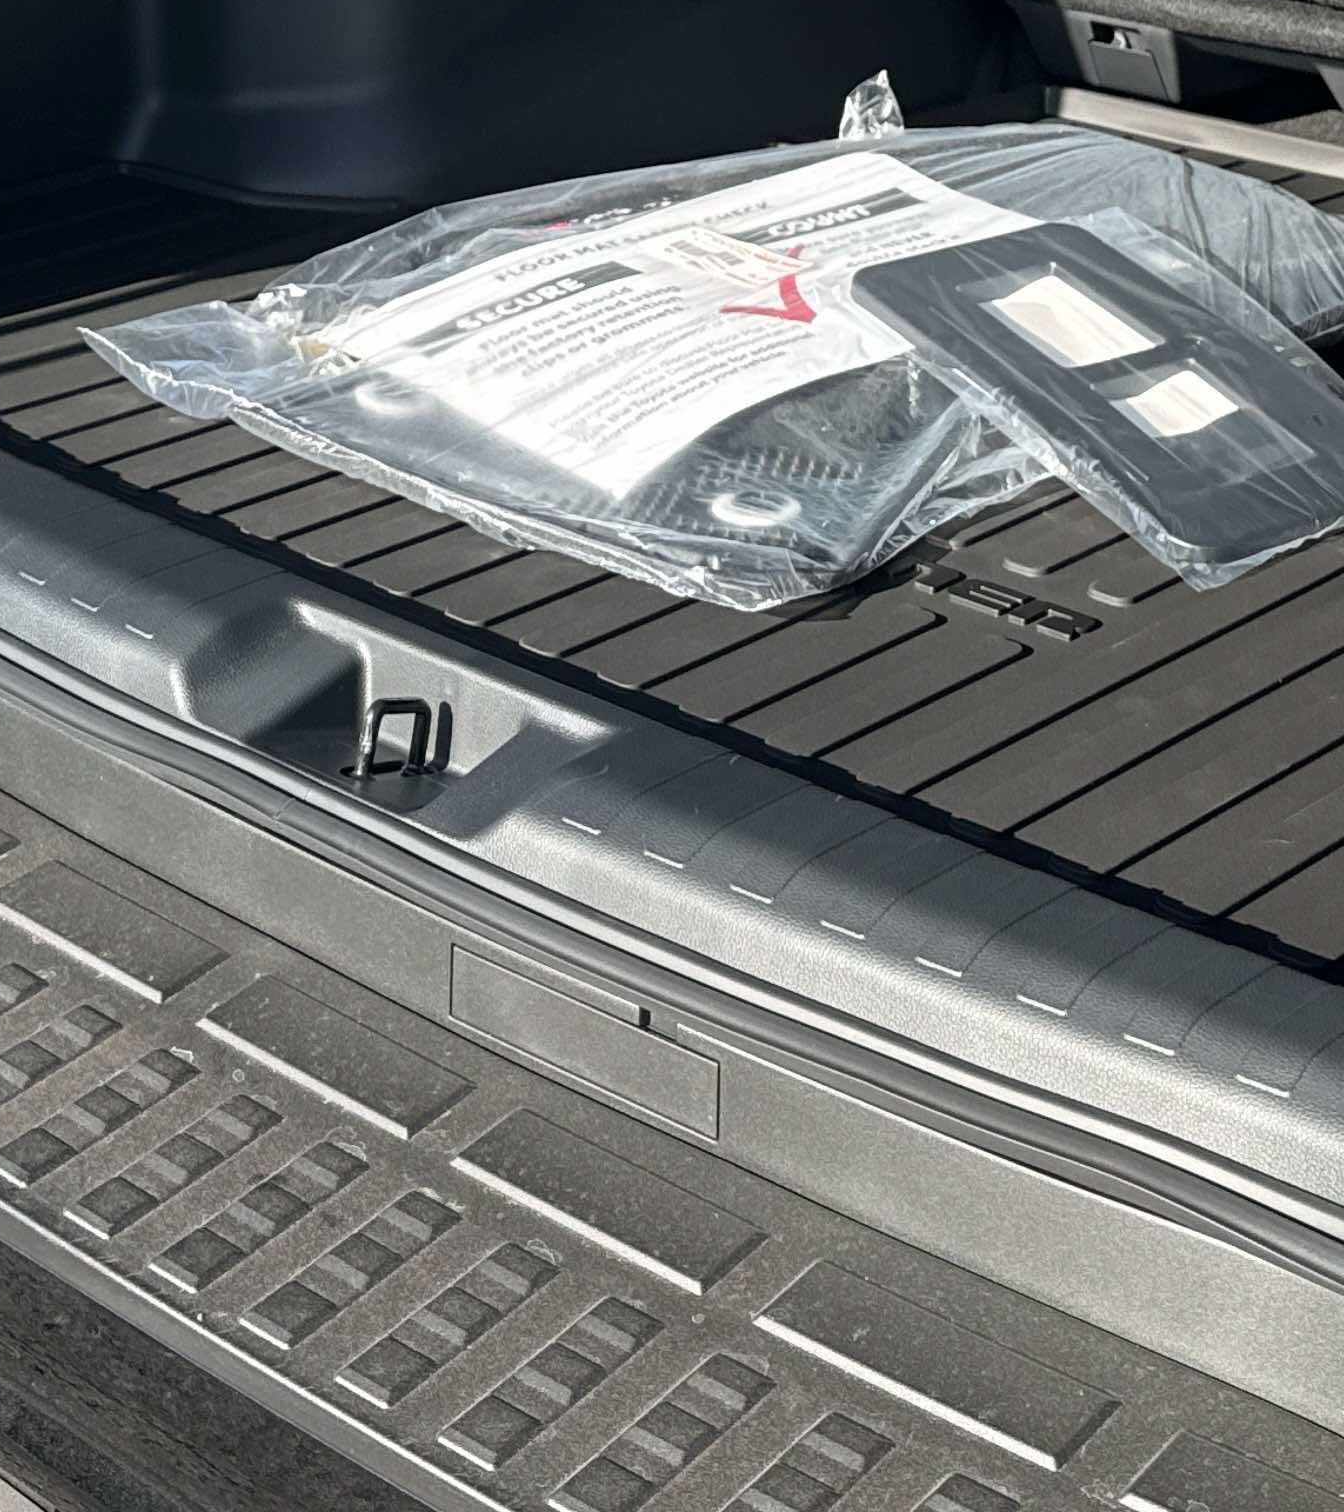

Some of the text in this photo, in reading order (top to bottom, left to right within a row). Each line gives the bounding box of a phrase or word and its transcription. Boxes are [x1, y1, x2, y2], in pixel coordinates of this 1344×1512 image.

[456, 277, 587, 332] SECURE
[557, 300, 627, 330] secured
[630, 283, 683, 303] using
[572, 285, 634, 313] should
[598, 296, 684, 328] retention
[591, 303, 690, 345] grommets.
